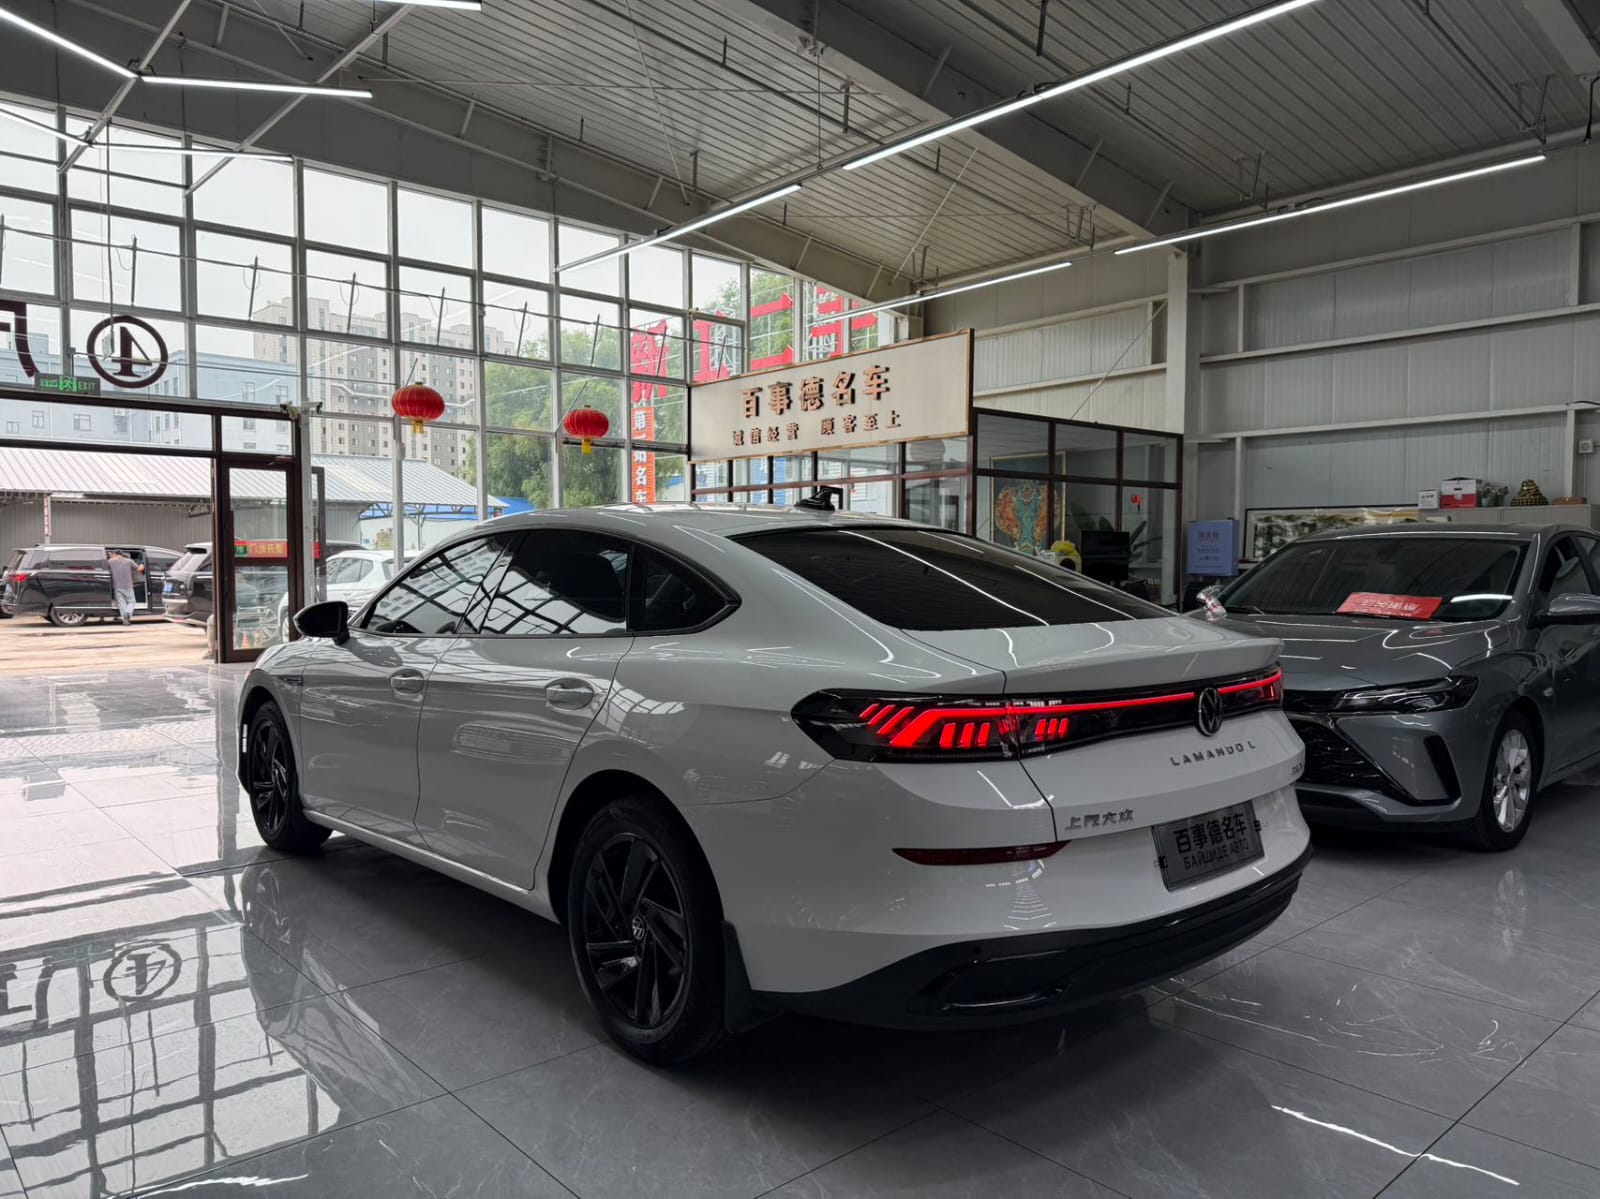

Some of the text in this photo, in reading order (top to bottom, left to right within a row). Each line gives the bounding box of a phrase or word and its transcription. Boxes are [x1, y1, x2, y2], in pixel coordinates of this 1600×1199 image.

[741, 365, 890, 418] 百事德名车
[733, 410, 901, 446] 诚信经营 顾客至上
[1169, 741, 1256, 766] LAMANDO L
[1173, 813, 1247, 854] 百事德名车
